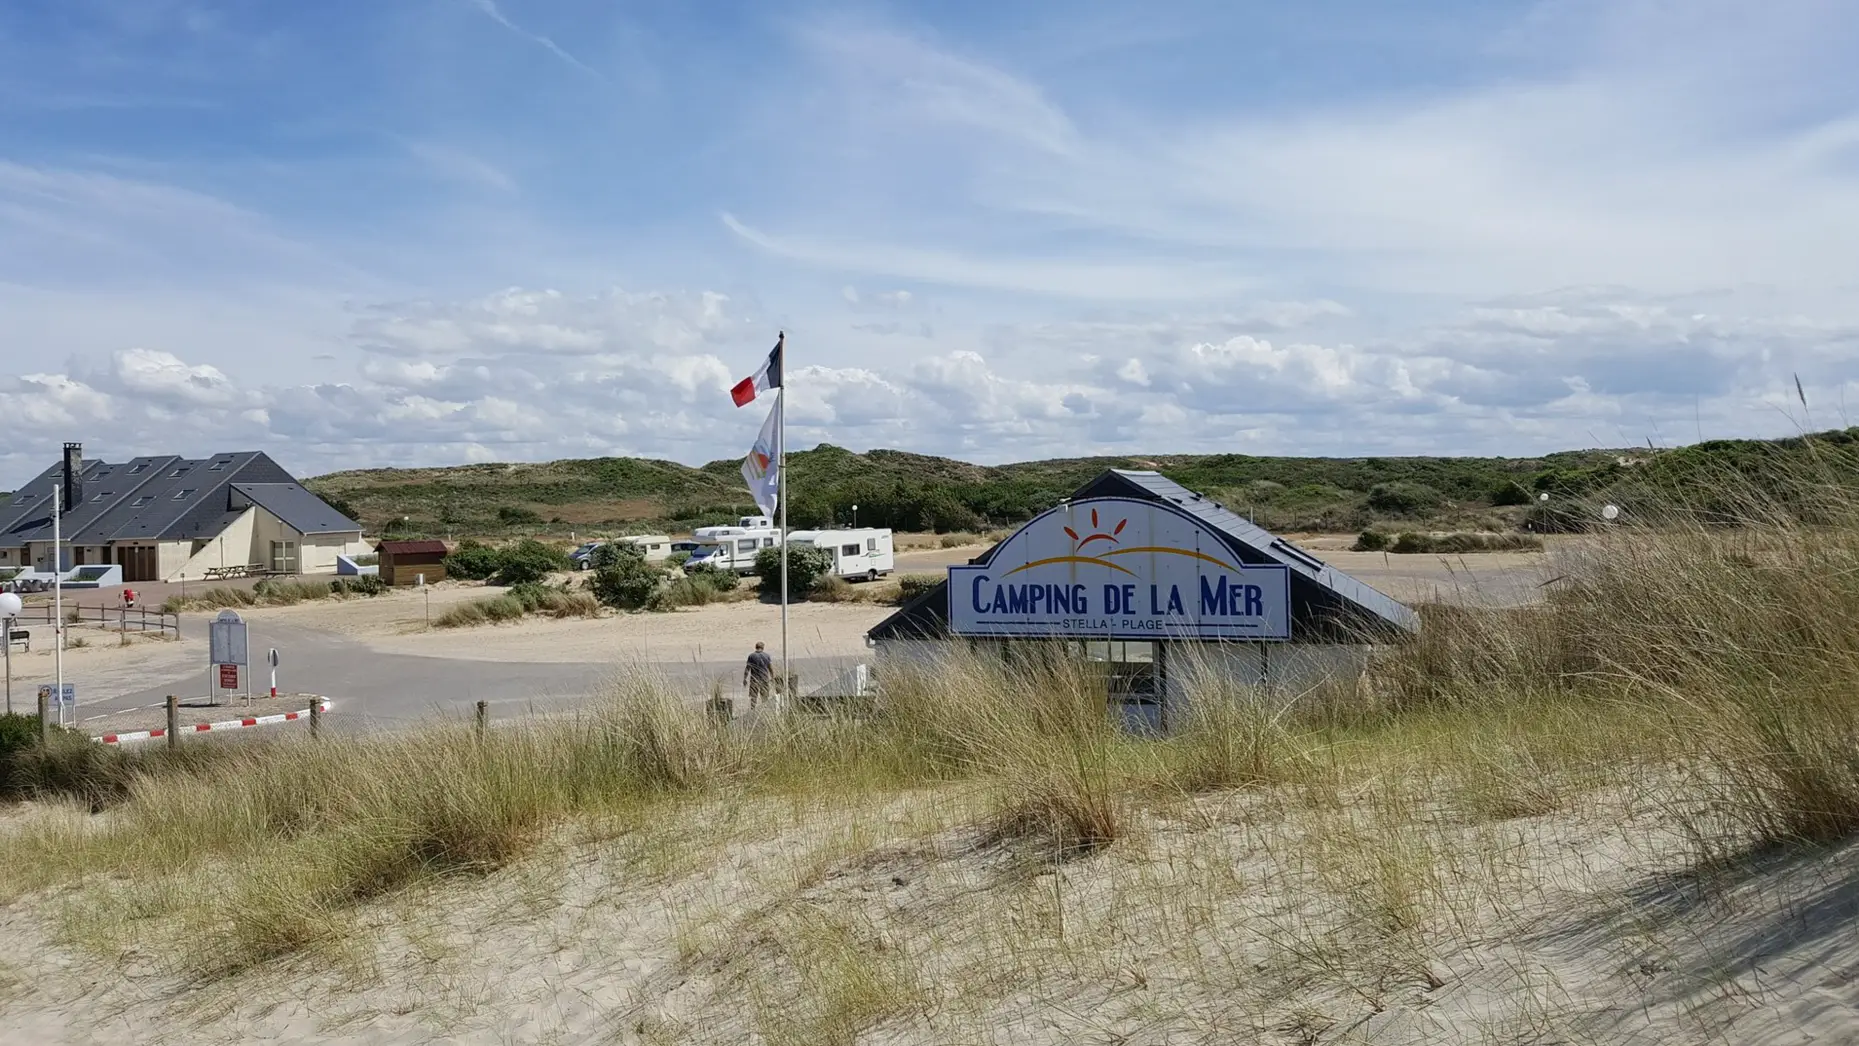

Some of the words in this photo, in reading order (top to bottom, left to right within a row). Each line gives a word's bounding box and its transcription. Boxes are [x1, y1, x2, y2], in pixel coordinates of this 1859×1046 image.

[972, 575, 1087, 614] CAMPING
[1104, 584, 1136, 615] DE
[1150, 584, 1184, 615] LA
[1200, 575, 1263, 616] MER
[1062, 619, 1108, 629] STELLA
[1122, 619, 1163, 630] PLAGE
